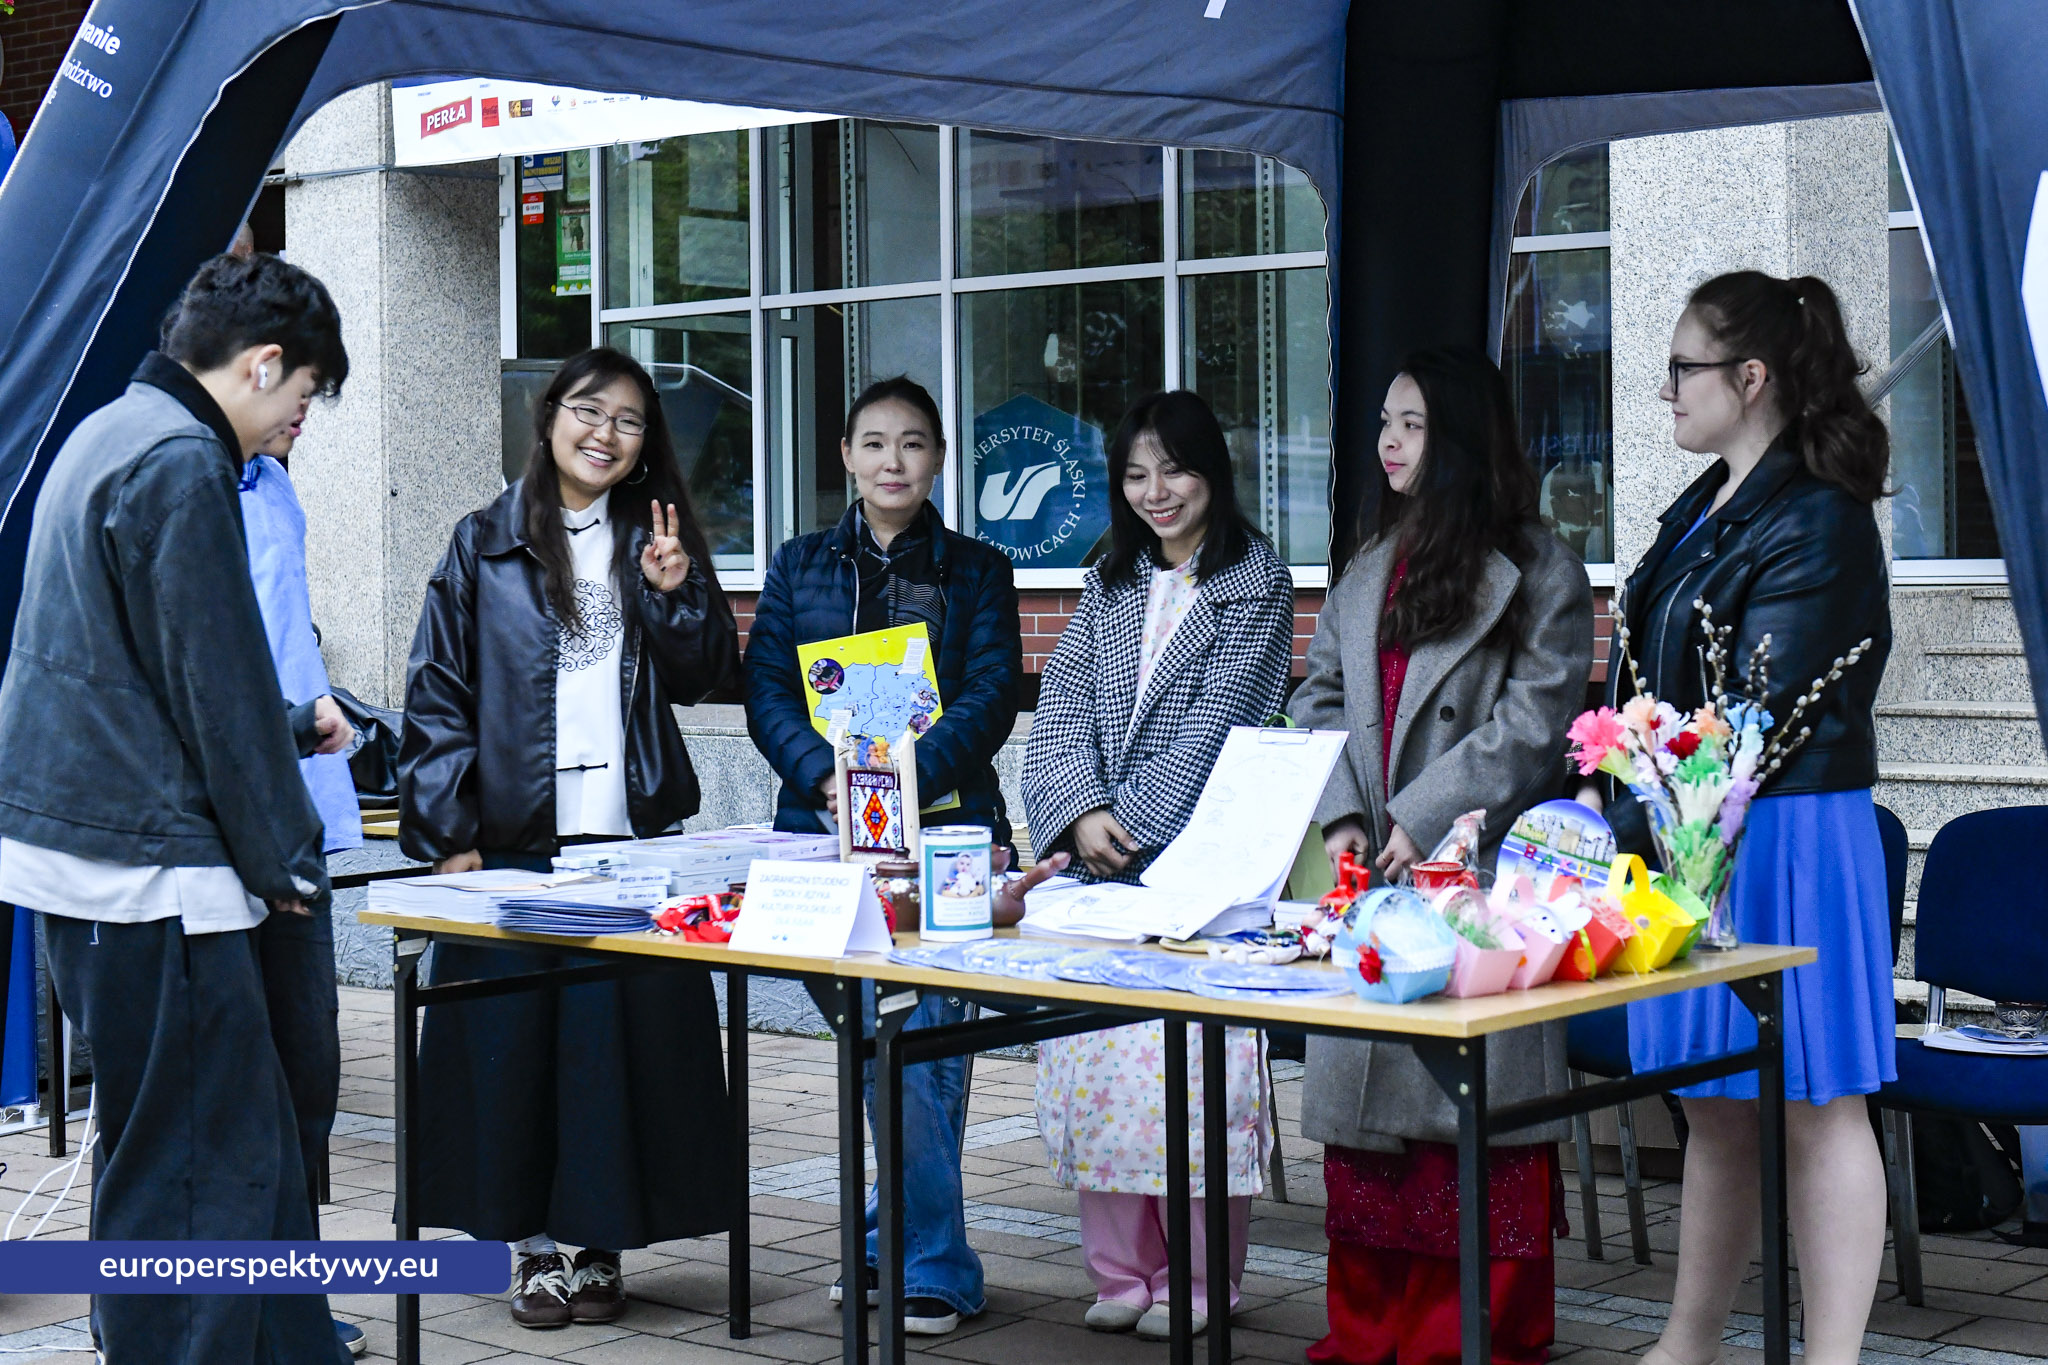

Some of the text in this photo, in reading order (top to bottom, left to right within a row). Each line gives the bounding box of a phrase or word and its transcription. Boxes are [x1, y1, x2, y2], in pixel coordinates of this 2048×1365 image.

[426, 104, 466, 132] PERŁA
[1052, 438, 1086, 499] ŚLĄSKI
[1523, 842, 1592, 878] BAKU
